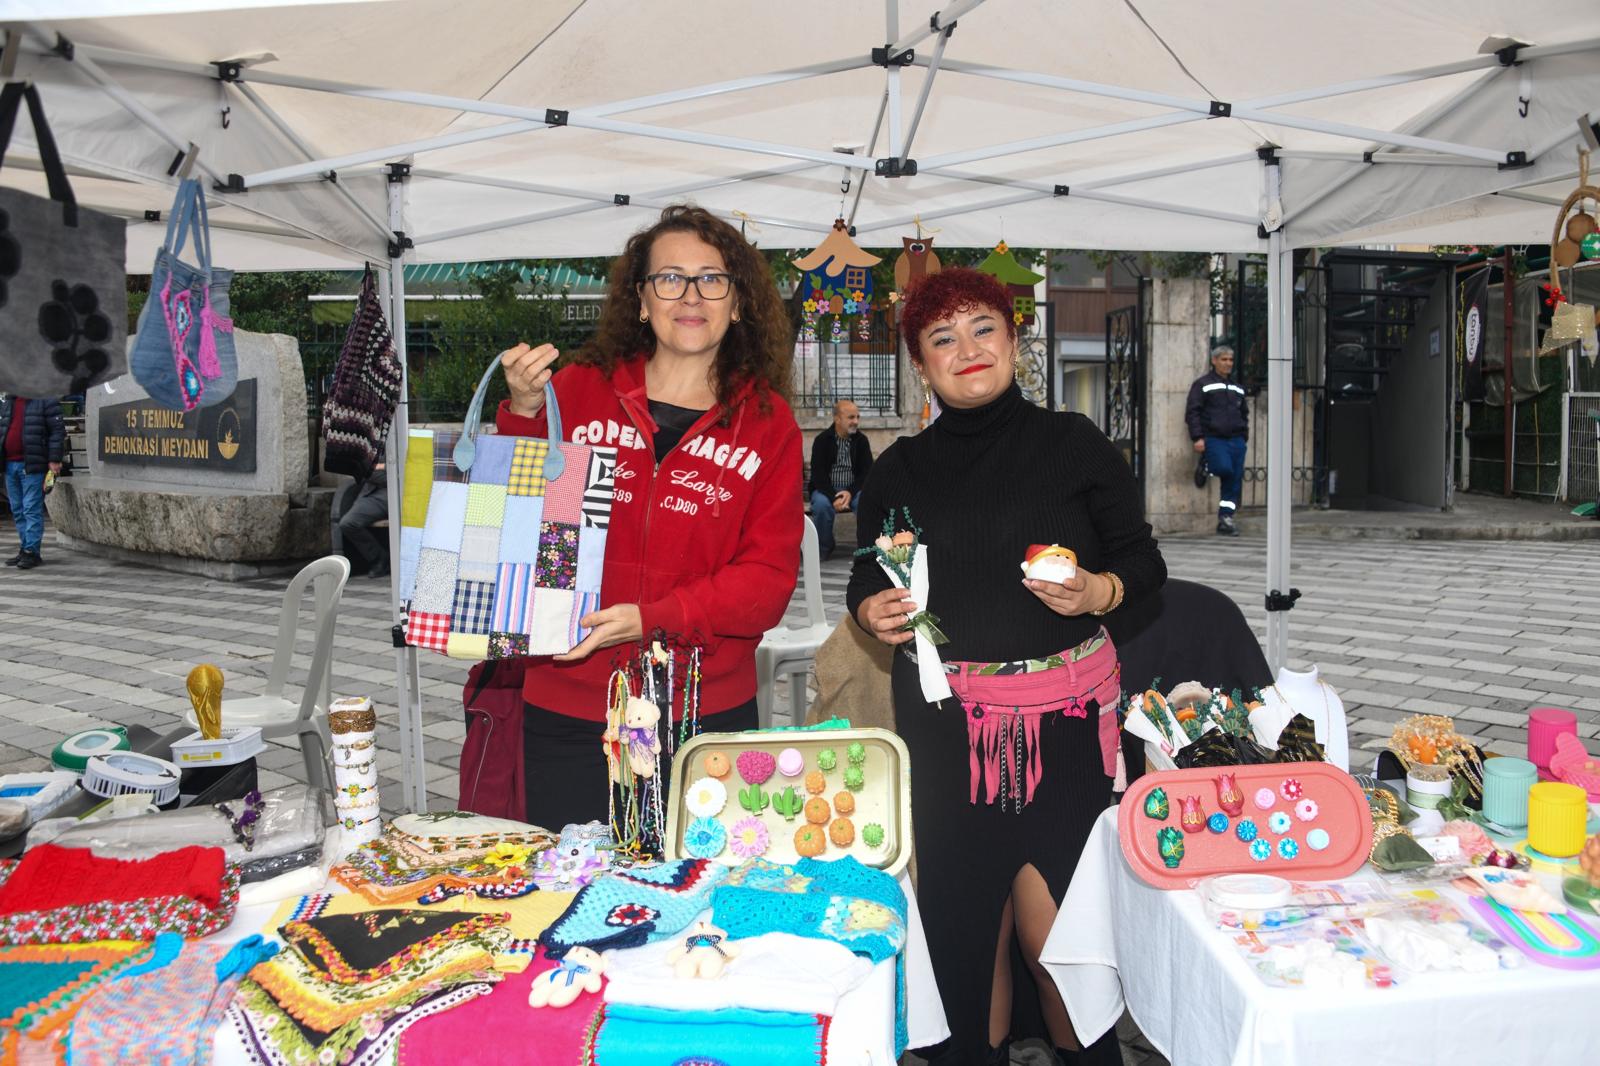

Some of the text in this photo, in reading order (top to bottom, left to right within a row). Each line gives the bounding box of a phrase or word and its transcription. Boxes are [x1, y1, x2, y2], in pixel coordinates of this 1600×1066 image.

[126, 409, 184, 429] 15 TEMMUZ
[104, 433, 209, 459] DEMOKRASİ MEYDANI
